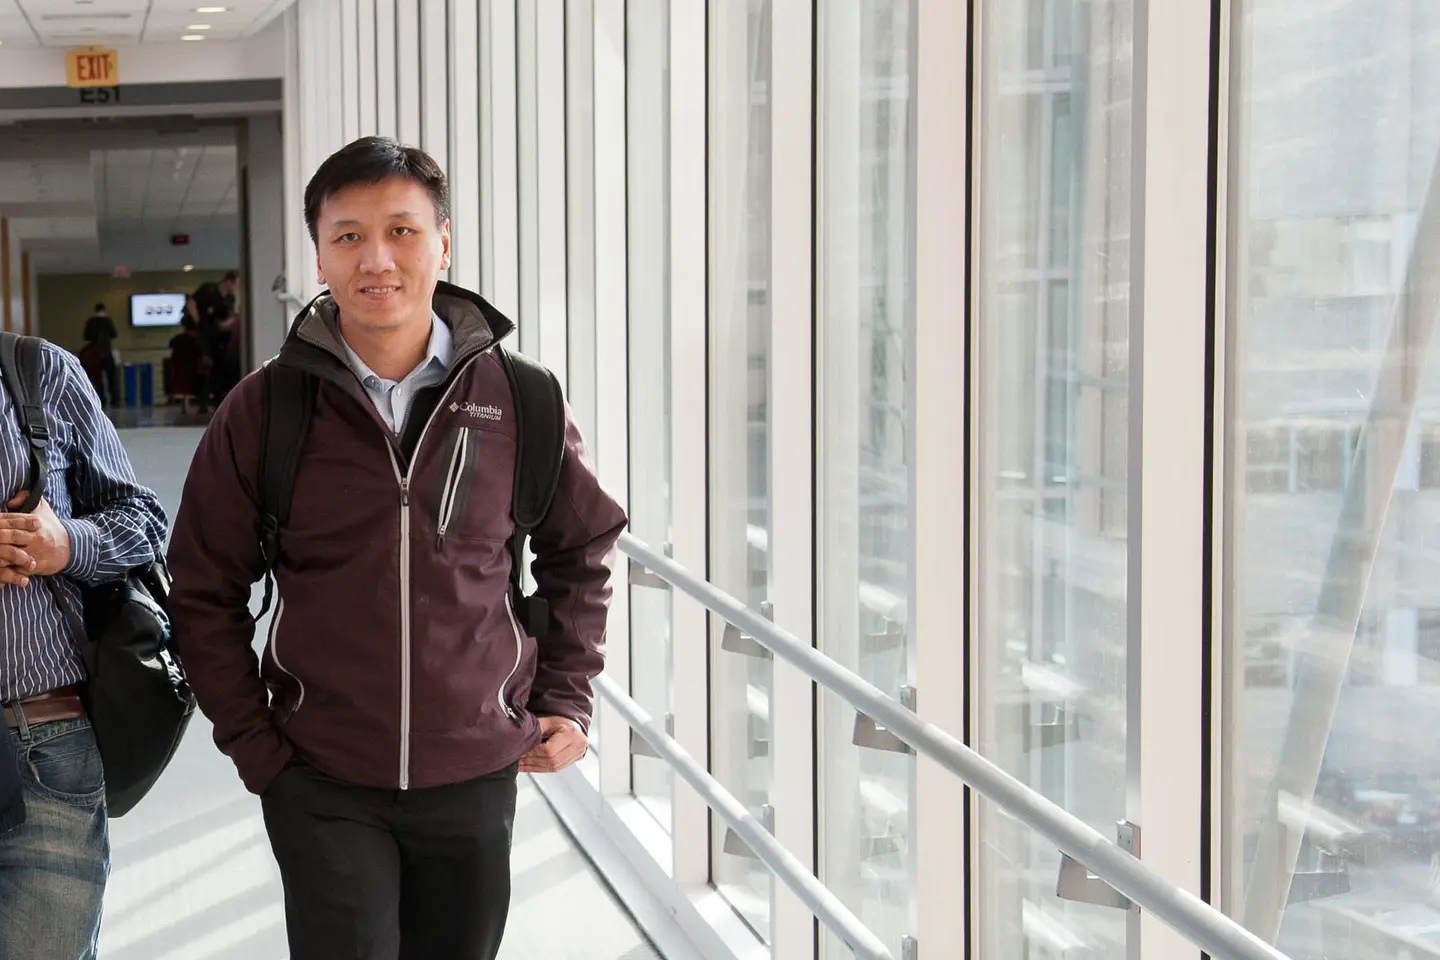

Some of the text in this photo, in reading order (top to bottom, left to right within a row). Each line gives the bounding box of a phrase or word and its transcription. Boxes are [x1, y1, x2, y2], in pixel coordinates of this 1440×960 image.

[76, 54, 110, 81] EXIT
[460, 401, 502, 416] Columbia
[470, 411, 502, 421] TITANIUM
